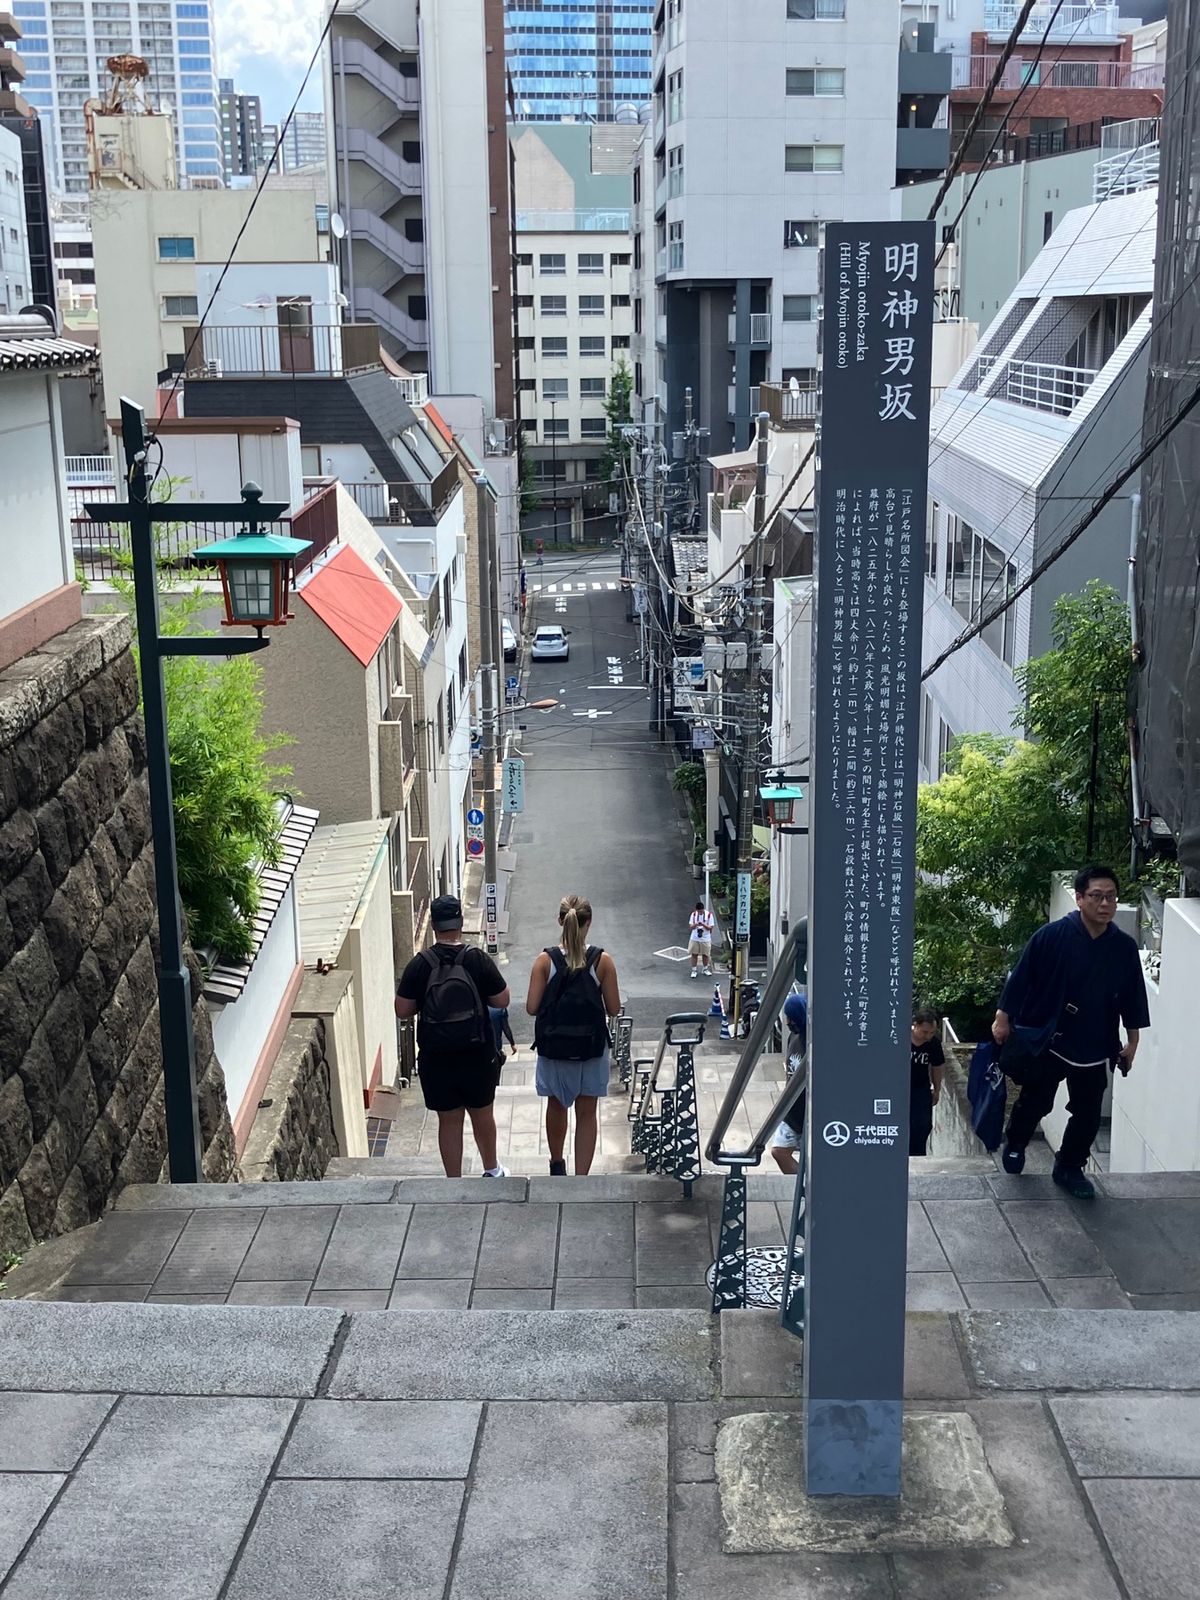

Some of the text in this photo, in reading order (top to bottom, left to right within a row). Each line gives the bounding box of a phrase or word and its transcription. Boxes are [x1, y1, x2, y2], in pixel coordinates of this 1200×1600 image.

[836, 242, 851, 369] (Hill of Myojin otoko)
[856, 241, 871, 361] Myojin otoko-zaka
[878, 242, 919, 421] 明神男坂
[854, 1125, 899, 1136] 千代田区
[854, 1136, 895, 1146] chiyoda city
